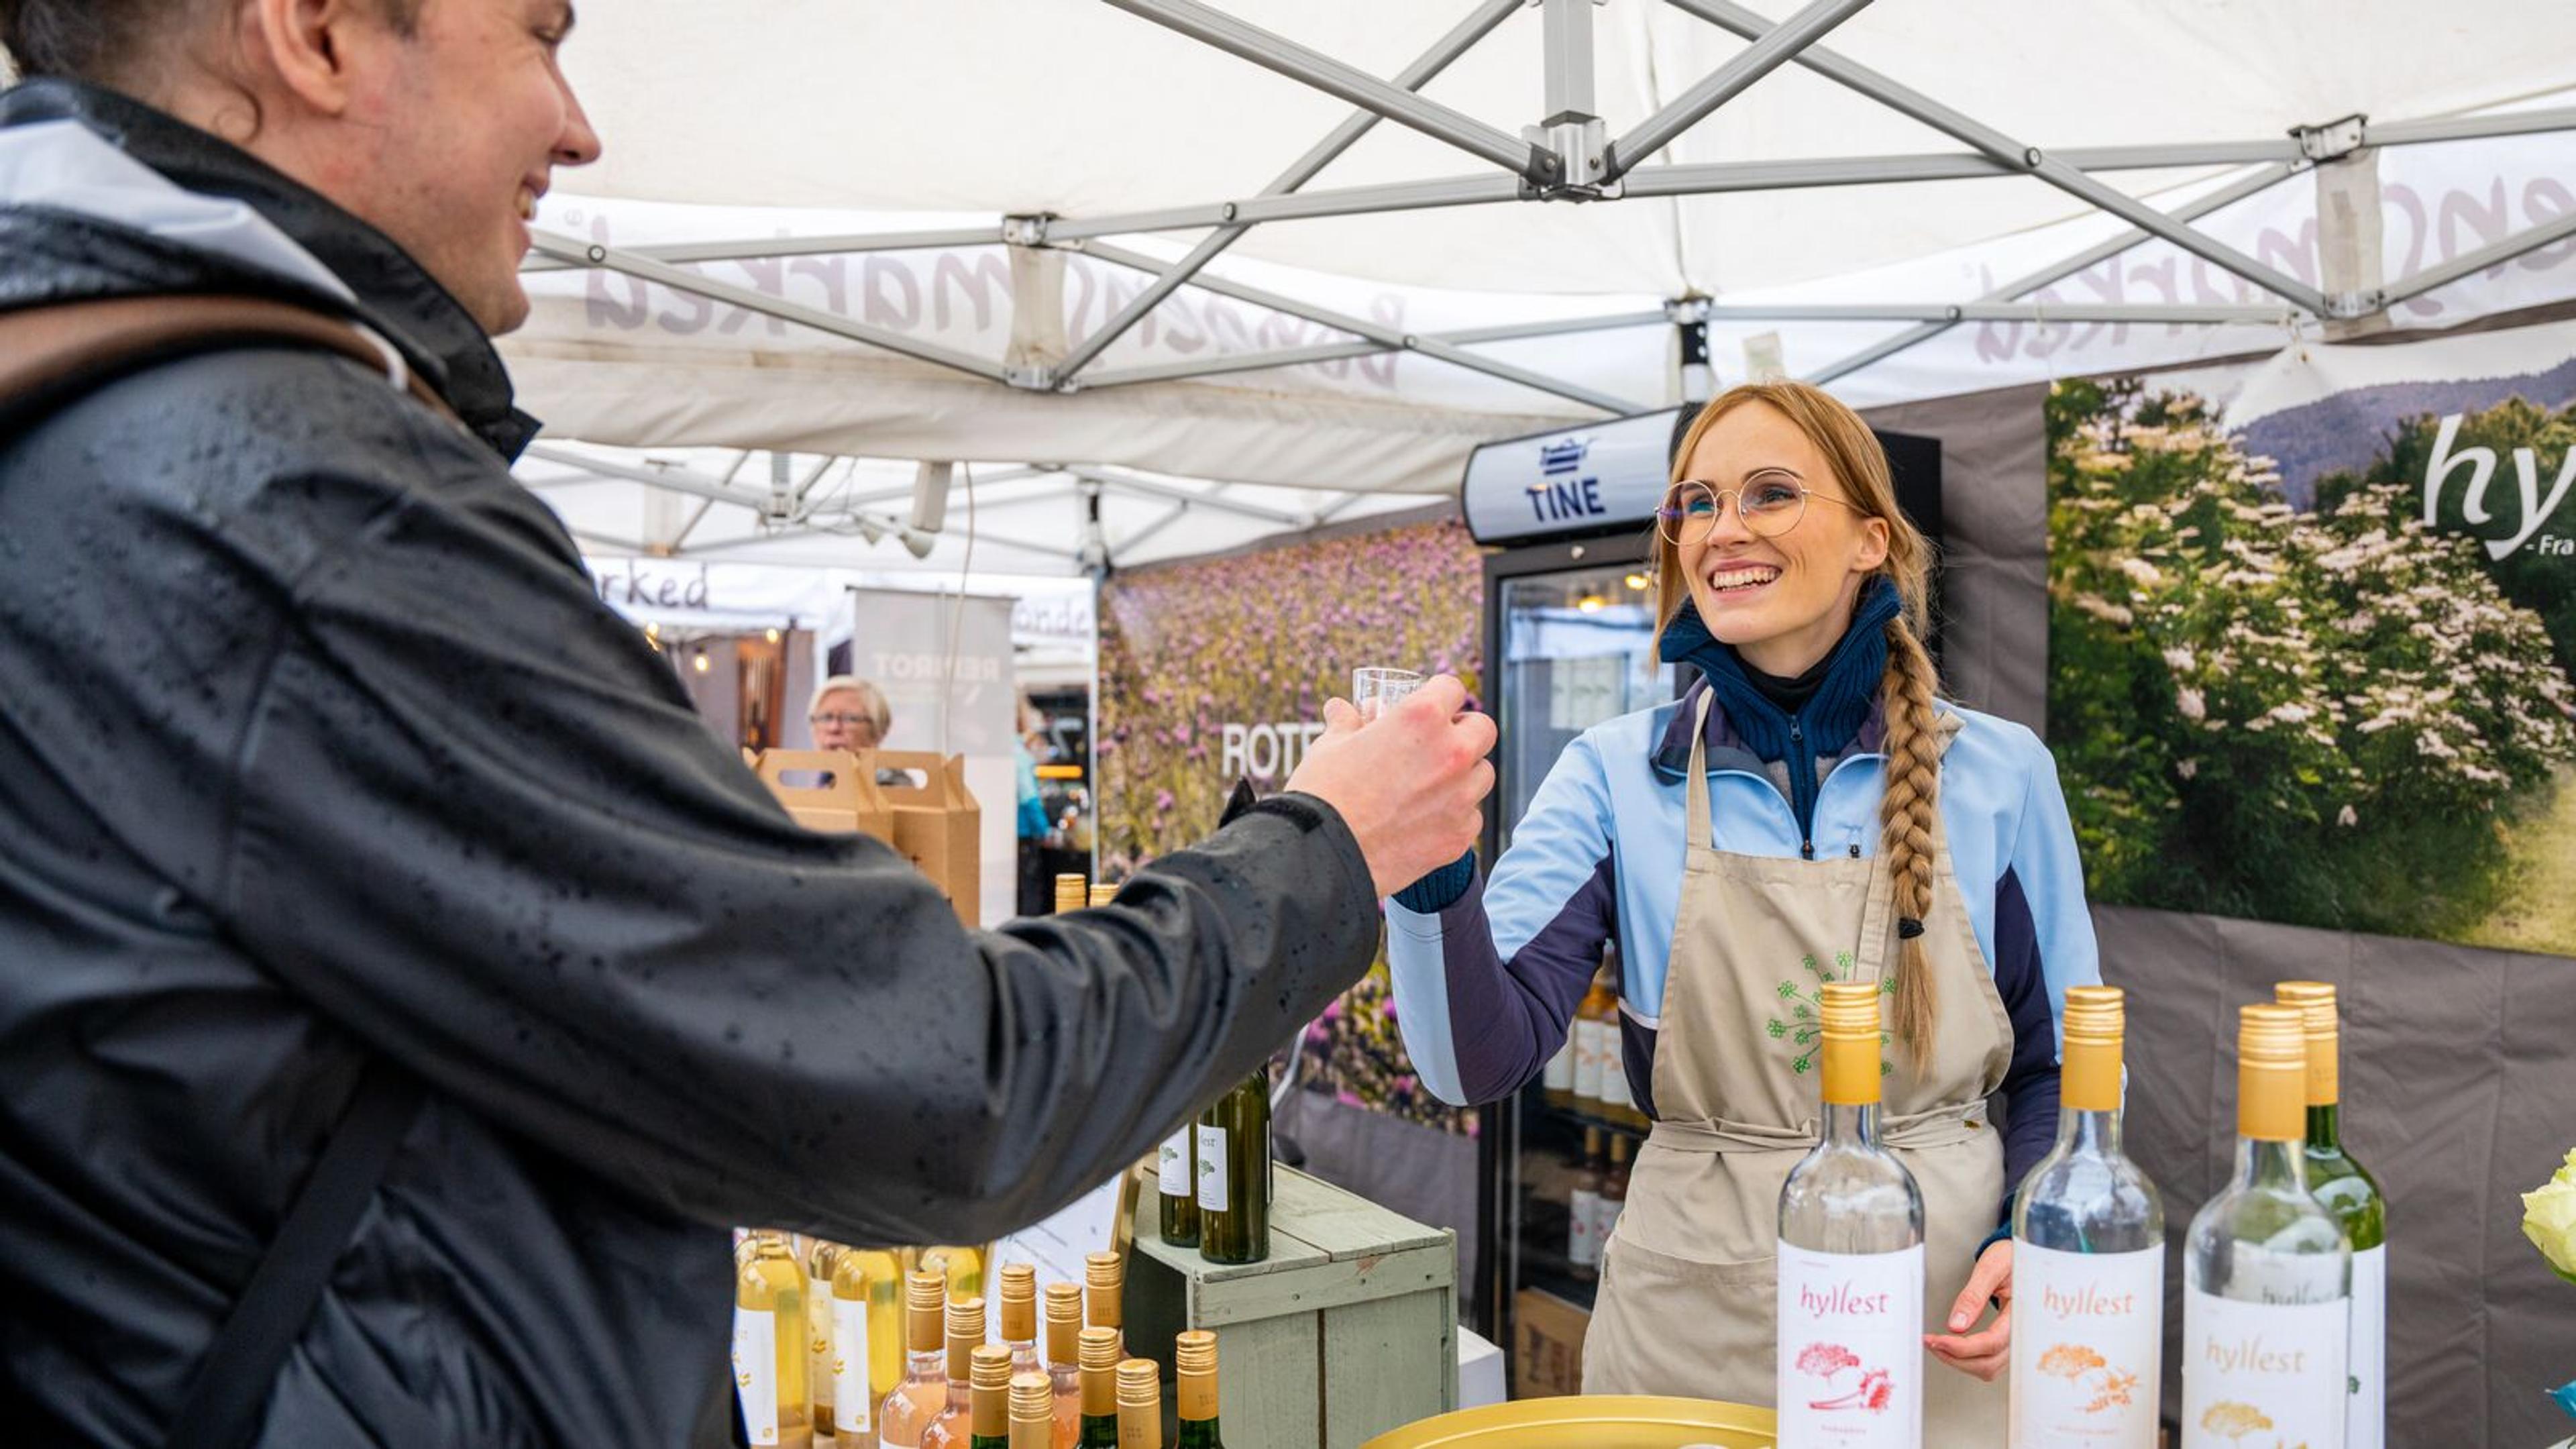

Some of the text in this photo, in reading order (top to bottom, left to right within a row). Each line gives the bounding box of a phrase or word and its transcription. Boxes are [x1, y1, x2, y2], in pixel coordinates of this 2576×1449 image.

[1525, 478, 1605, 522] TINE
[2423, 412, 2576, 561] hy
[2538, 534, 2576, 555] Fra
[1800, 1279, 1890, 1319] hyllest
[2043, 1279, 2135, 1320] hyllest
[2205, 1332, 2305, 1373] hyllest
